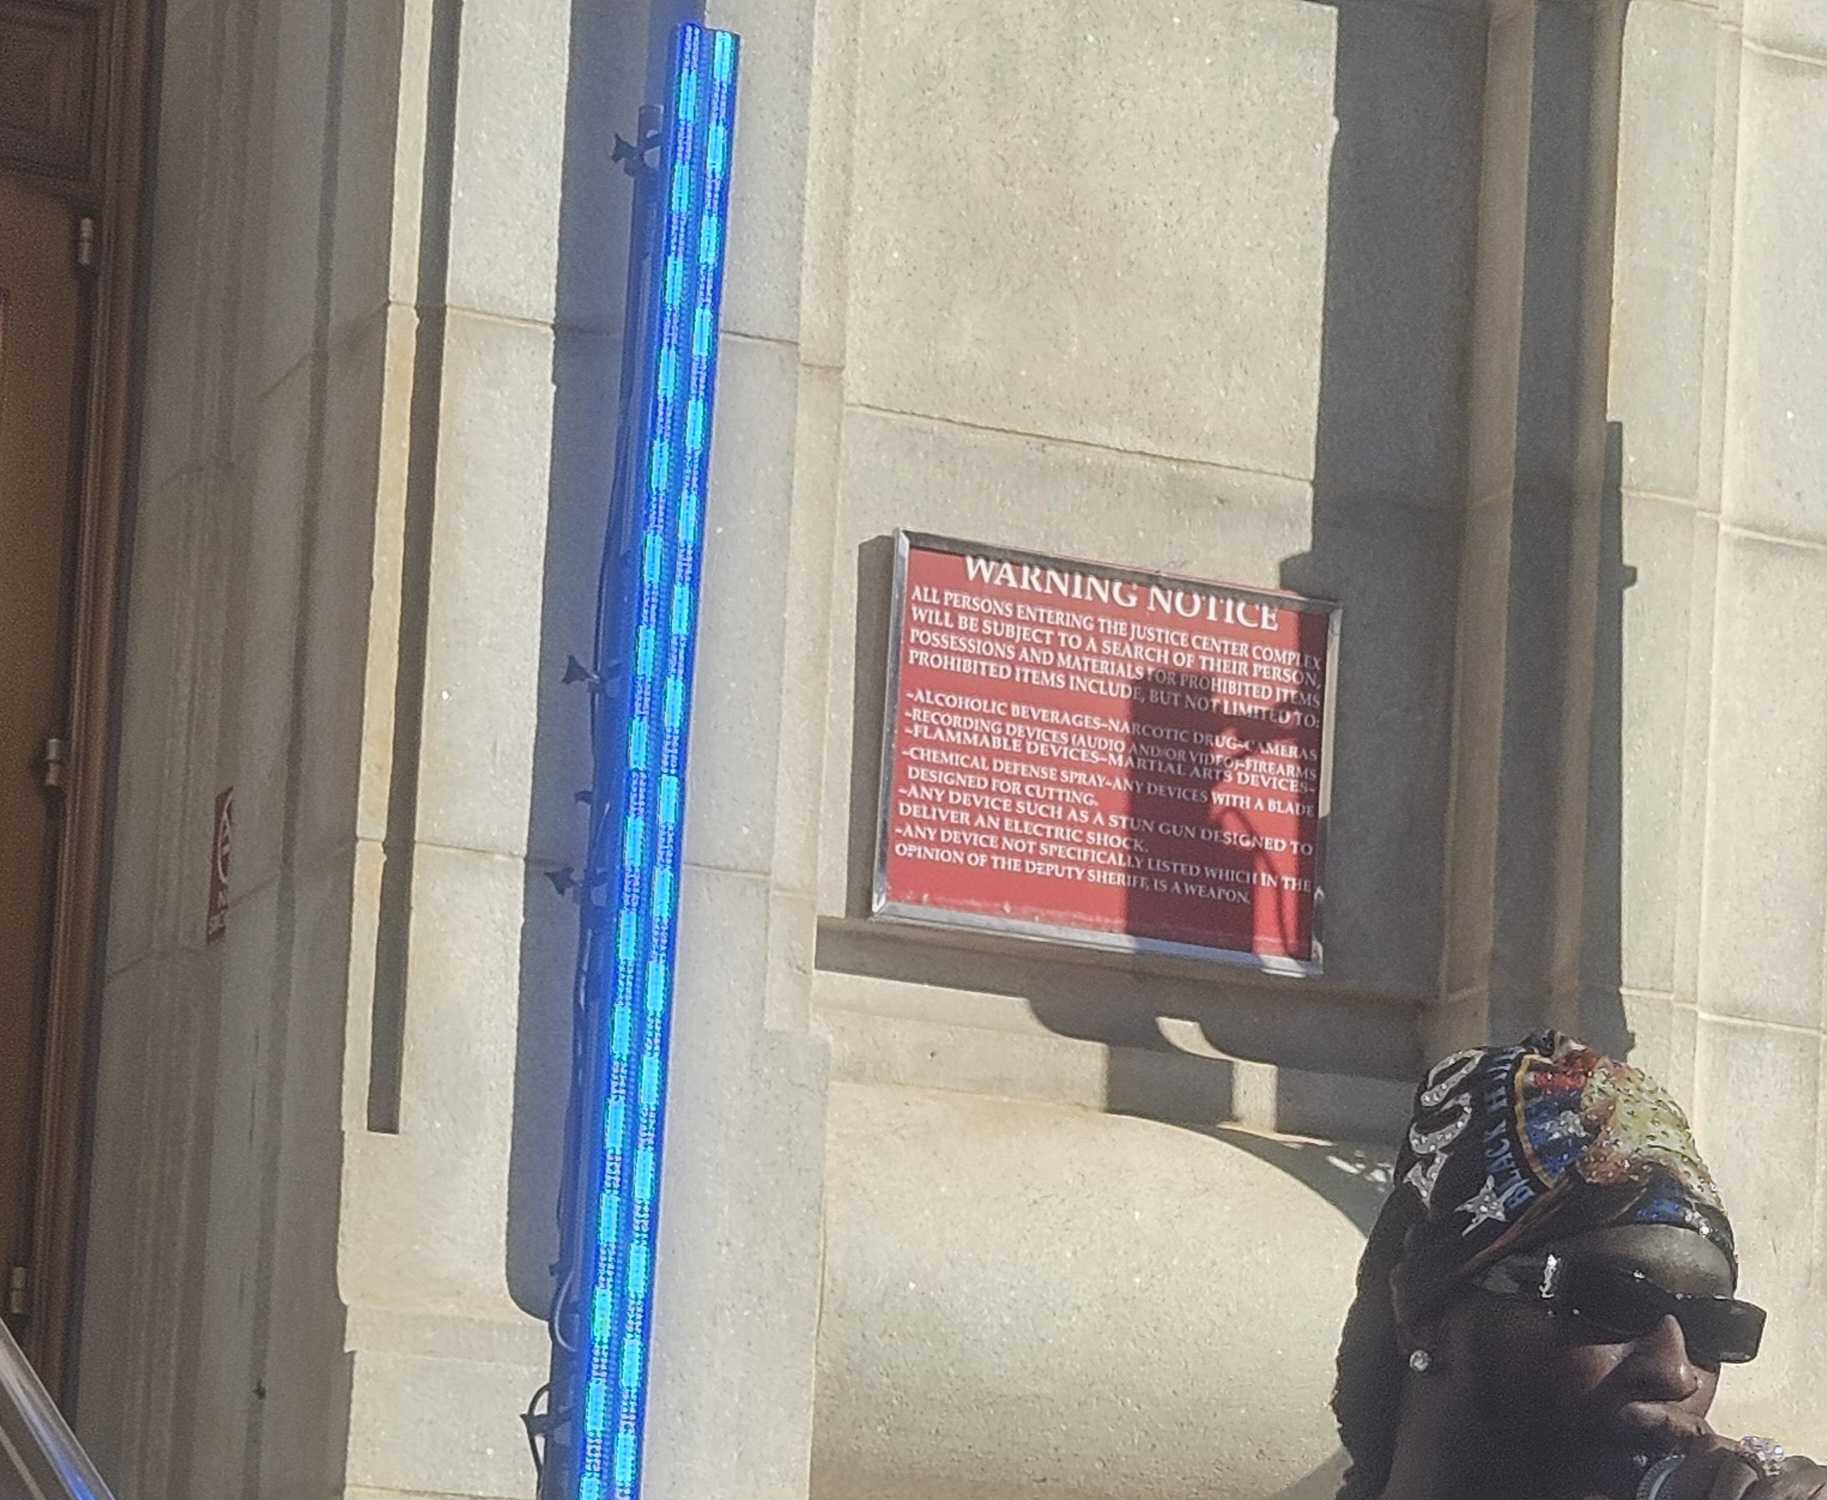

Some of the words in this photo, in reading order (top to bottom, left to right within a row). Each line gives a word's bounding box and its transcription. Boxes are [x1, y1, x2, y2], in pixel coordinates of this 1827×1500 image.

[965, 555, 1138, 608] WARNING
[1147, 584, 1279, 631] NOTICE
[911, 584, 940, 604] ALL
[943, 591, 1012, 617] PERSONS
[1017, 603, 1094, 631] ENTERING
[1098, 617, 1127, 636] THE
[1129, 623, 1189, 647] JUSTICE
[1191, 633, 1248, 657] CENTER
[1252, 644, 1321, 671] COMPLEX
[911, 605, 954, 627] WILL
[959, 613, 978, 633] BE
[982, 618, 1054, 645] SUBJECT
[1057, 630, 1081, 650] TO
[1085, 635, 1096, 653] A
[1101, 638, 1168, 664] SEARCH
[1172, 649, 1194, 669] OF
[1200, 654, 1248, 676] THEIR
[1252, 662, 1321, 689] PERSON,
[908, 648, 1010, 679] PROHIBITED
[1015, 666, 1065, 688] ITEMS
[1151, 688, 1178, 706] BUT
[1184, 694, 1218, 712] NOT
[1223, 699, 1290, 724] LIMITED
[910, 628, 1015, 659] POSSESSIONS
[1020, 646, 1054, 665] AND
[1057, 652, 1143, 680] MATERIALS
[1147, 667, 1176, 685] FOR
[1180, 671, 1271, 700] PROHIBITED
[1275, 688, 1321, 709] ITEMS
[1005, 722, 1068, 744] DEVICES
[907, 766, 989, 790] DESIGNED
[991, 778, 1021, 794] FOR
[1024, 783, 1098, 806] CUTTING.
[992, 759, 1057, 780] DEFENSE
[1146, 782, 1207, 802] DEVICES
[1211, 791, 1249, 809] WITH
[1254, 797, 1264, 811] A
[1268, 799, 1314, 817] BLADE
[1189, 765, 1231, 782] ARTS
[899, 802, 970, 824] DELIVER
[974, 813, 999, 829] AN
[1003, 818, 1084, 842] ELECTRIC
[1086, 831, 1148, 852] SHOCK.
[948, 790, 1011, 811] DEVICE
[1015, 800, 1062, 819] SUCH
[1067, 807, 1089, 824] AS
[1093, 811, 1104, 826] A
[1108, 814, 1153, 832] STUN
[1158, 822, 1196, 838] GUN
[1200, 828, 1286, 852] DESIGNED
[1290, 840, 1313, 856] TO
[895, 842, 964, 864] OPINION
[967, 851, 987, 867] OF
[989, 855, 1021, 871] THE
[1024, 860, 1085, 880] DEPUTY
[1153, 877, 1167, 893] IS
[1171, 881, 1182, 894] A
[940, 828, 998, 848] DEVICE
[1001, 836, 1036, 853] NOT
[1039, 842, 1142, 868] SPECIFICALLY
[1147, 858, 1200, 876] LISTED
[1204, 866, 1257, 884] WHICH
[1260, 872, 1278, 888] IN
[1281, 876, 1311, 892] THE
[1485, 1119, 1536, 1209] BLACK
